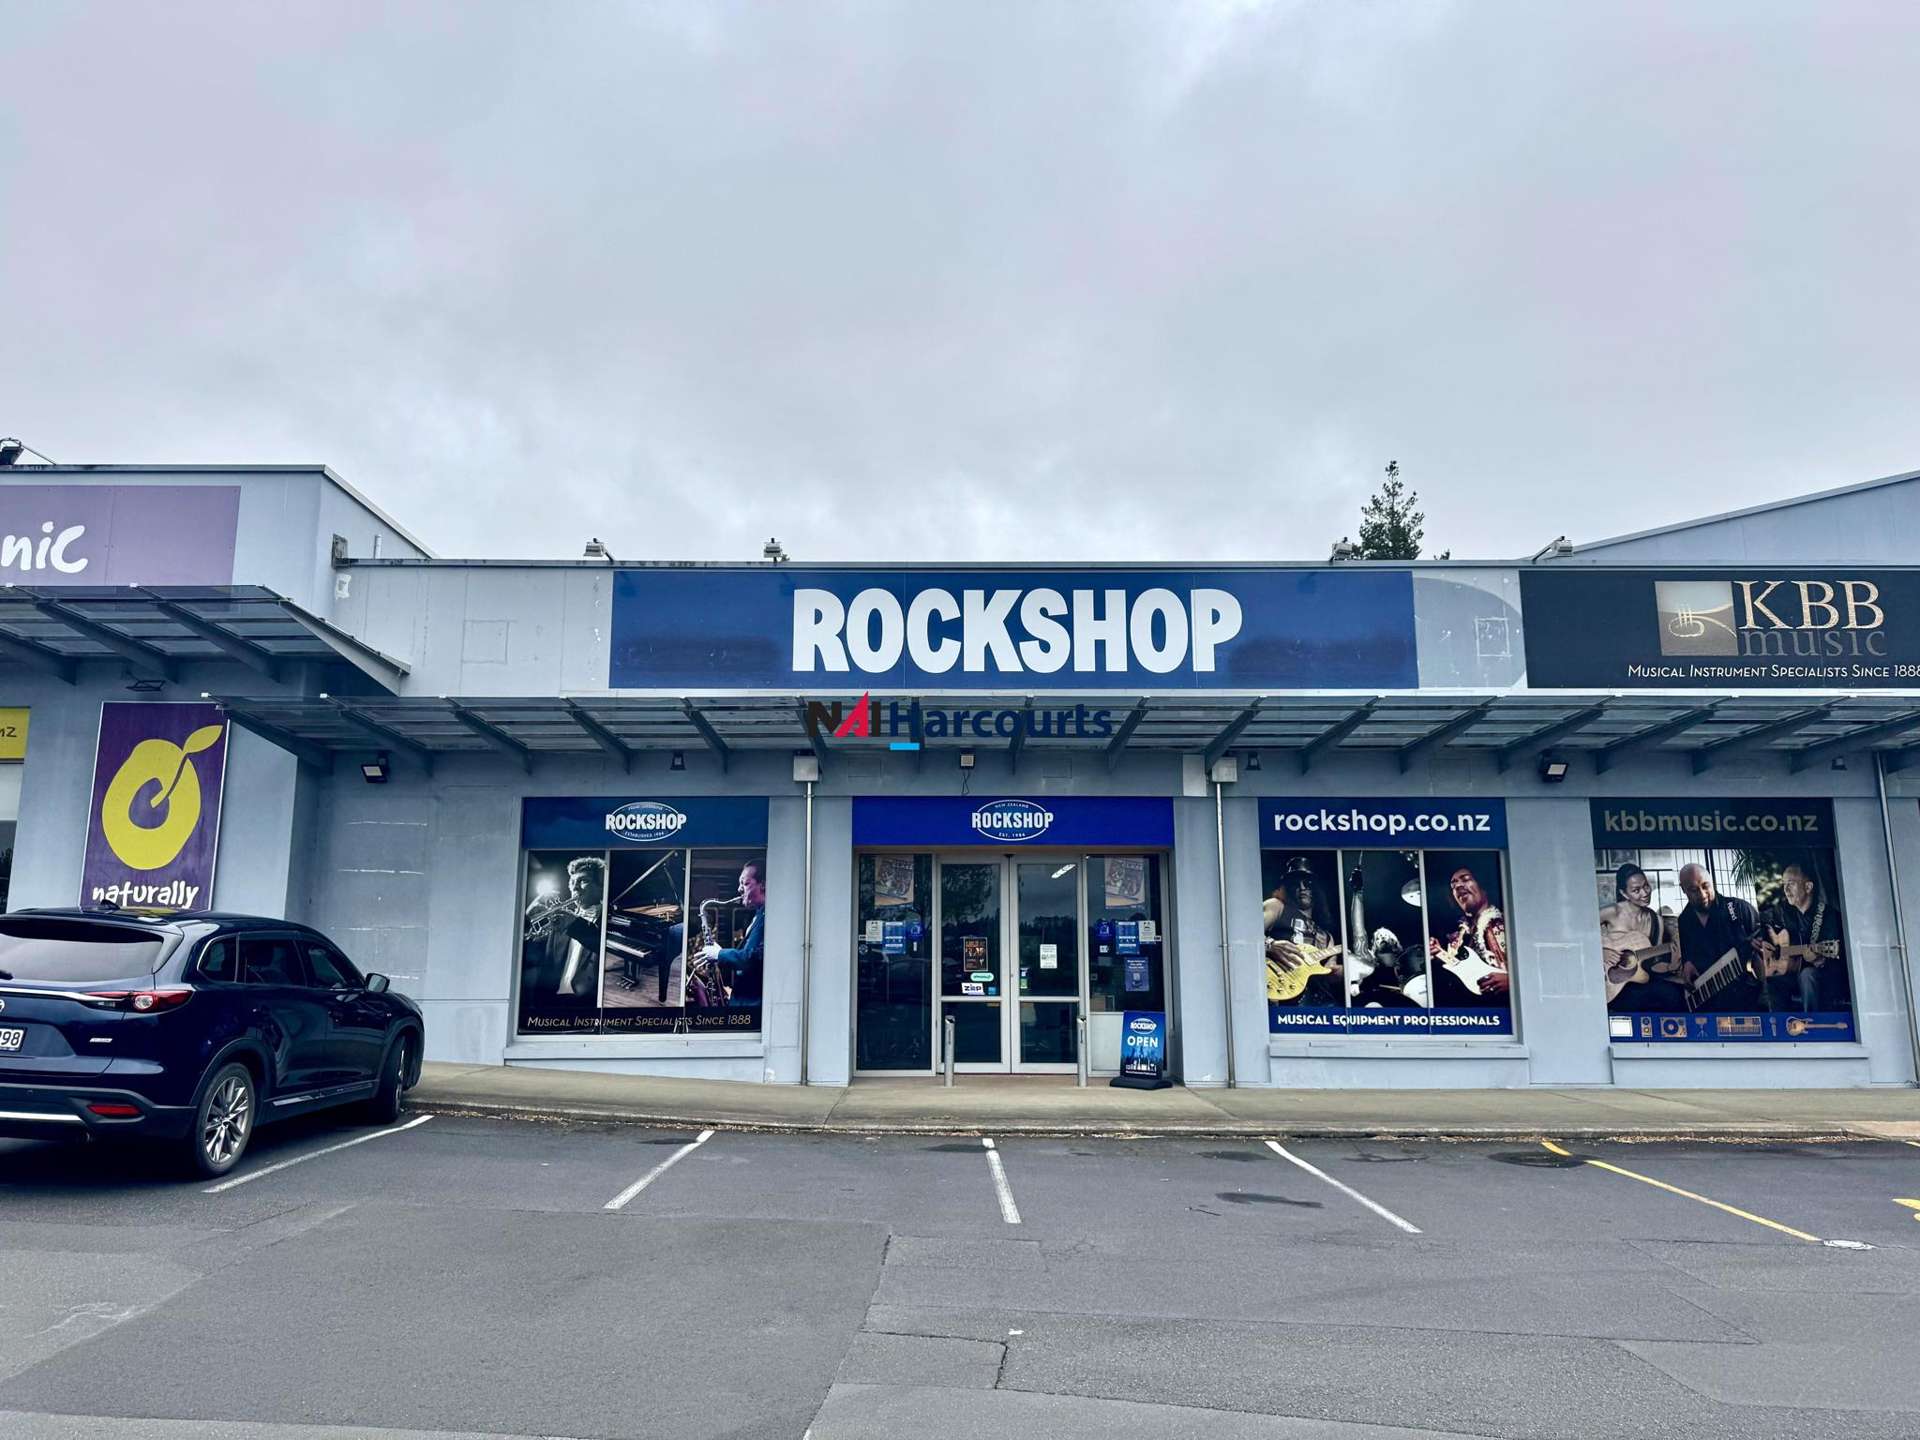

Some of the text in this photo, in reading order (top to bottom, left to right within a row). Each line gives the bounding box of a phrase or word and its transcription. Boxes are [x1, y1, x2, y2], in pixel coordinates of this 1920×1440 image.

[1734, 580, 1884, 630] KBB
[793, 588, 1242, 674] ROCKSHOP
[1743, 631, 1887, 656] music
[1628, 664, 1685, 678] MUSICAL
[1690, 664, 1767, 678] INSTRUMENT
[1770, 664, 1848, 678] SPECIALISTS
[1852, 664, 1890, 678] SINCE
[605, 813, 687, 830] ROCKSHOP
[971, 812, 1054, 829] ROCKSHOP
[1274, 809, 1491, 835] rockshop.co.nz
[1604, 810, 1819, 832] kbbmusic.co.nz
[92, 880, 199, 909] naturally
[1277, 1015, 1500, 1026] MUSICAL EQUIPMENT PROFESSIONALS
[0, 1031, 21, 1046] 98
[1127, 1035, 1159, 1048] OPEN
